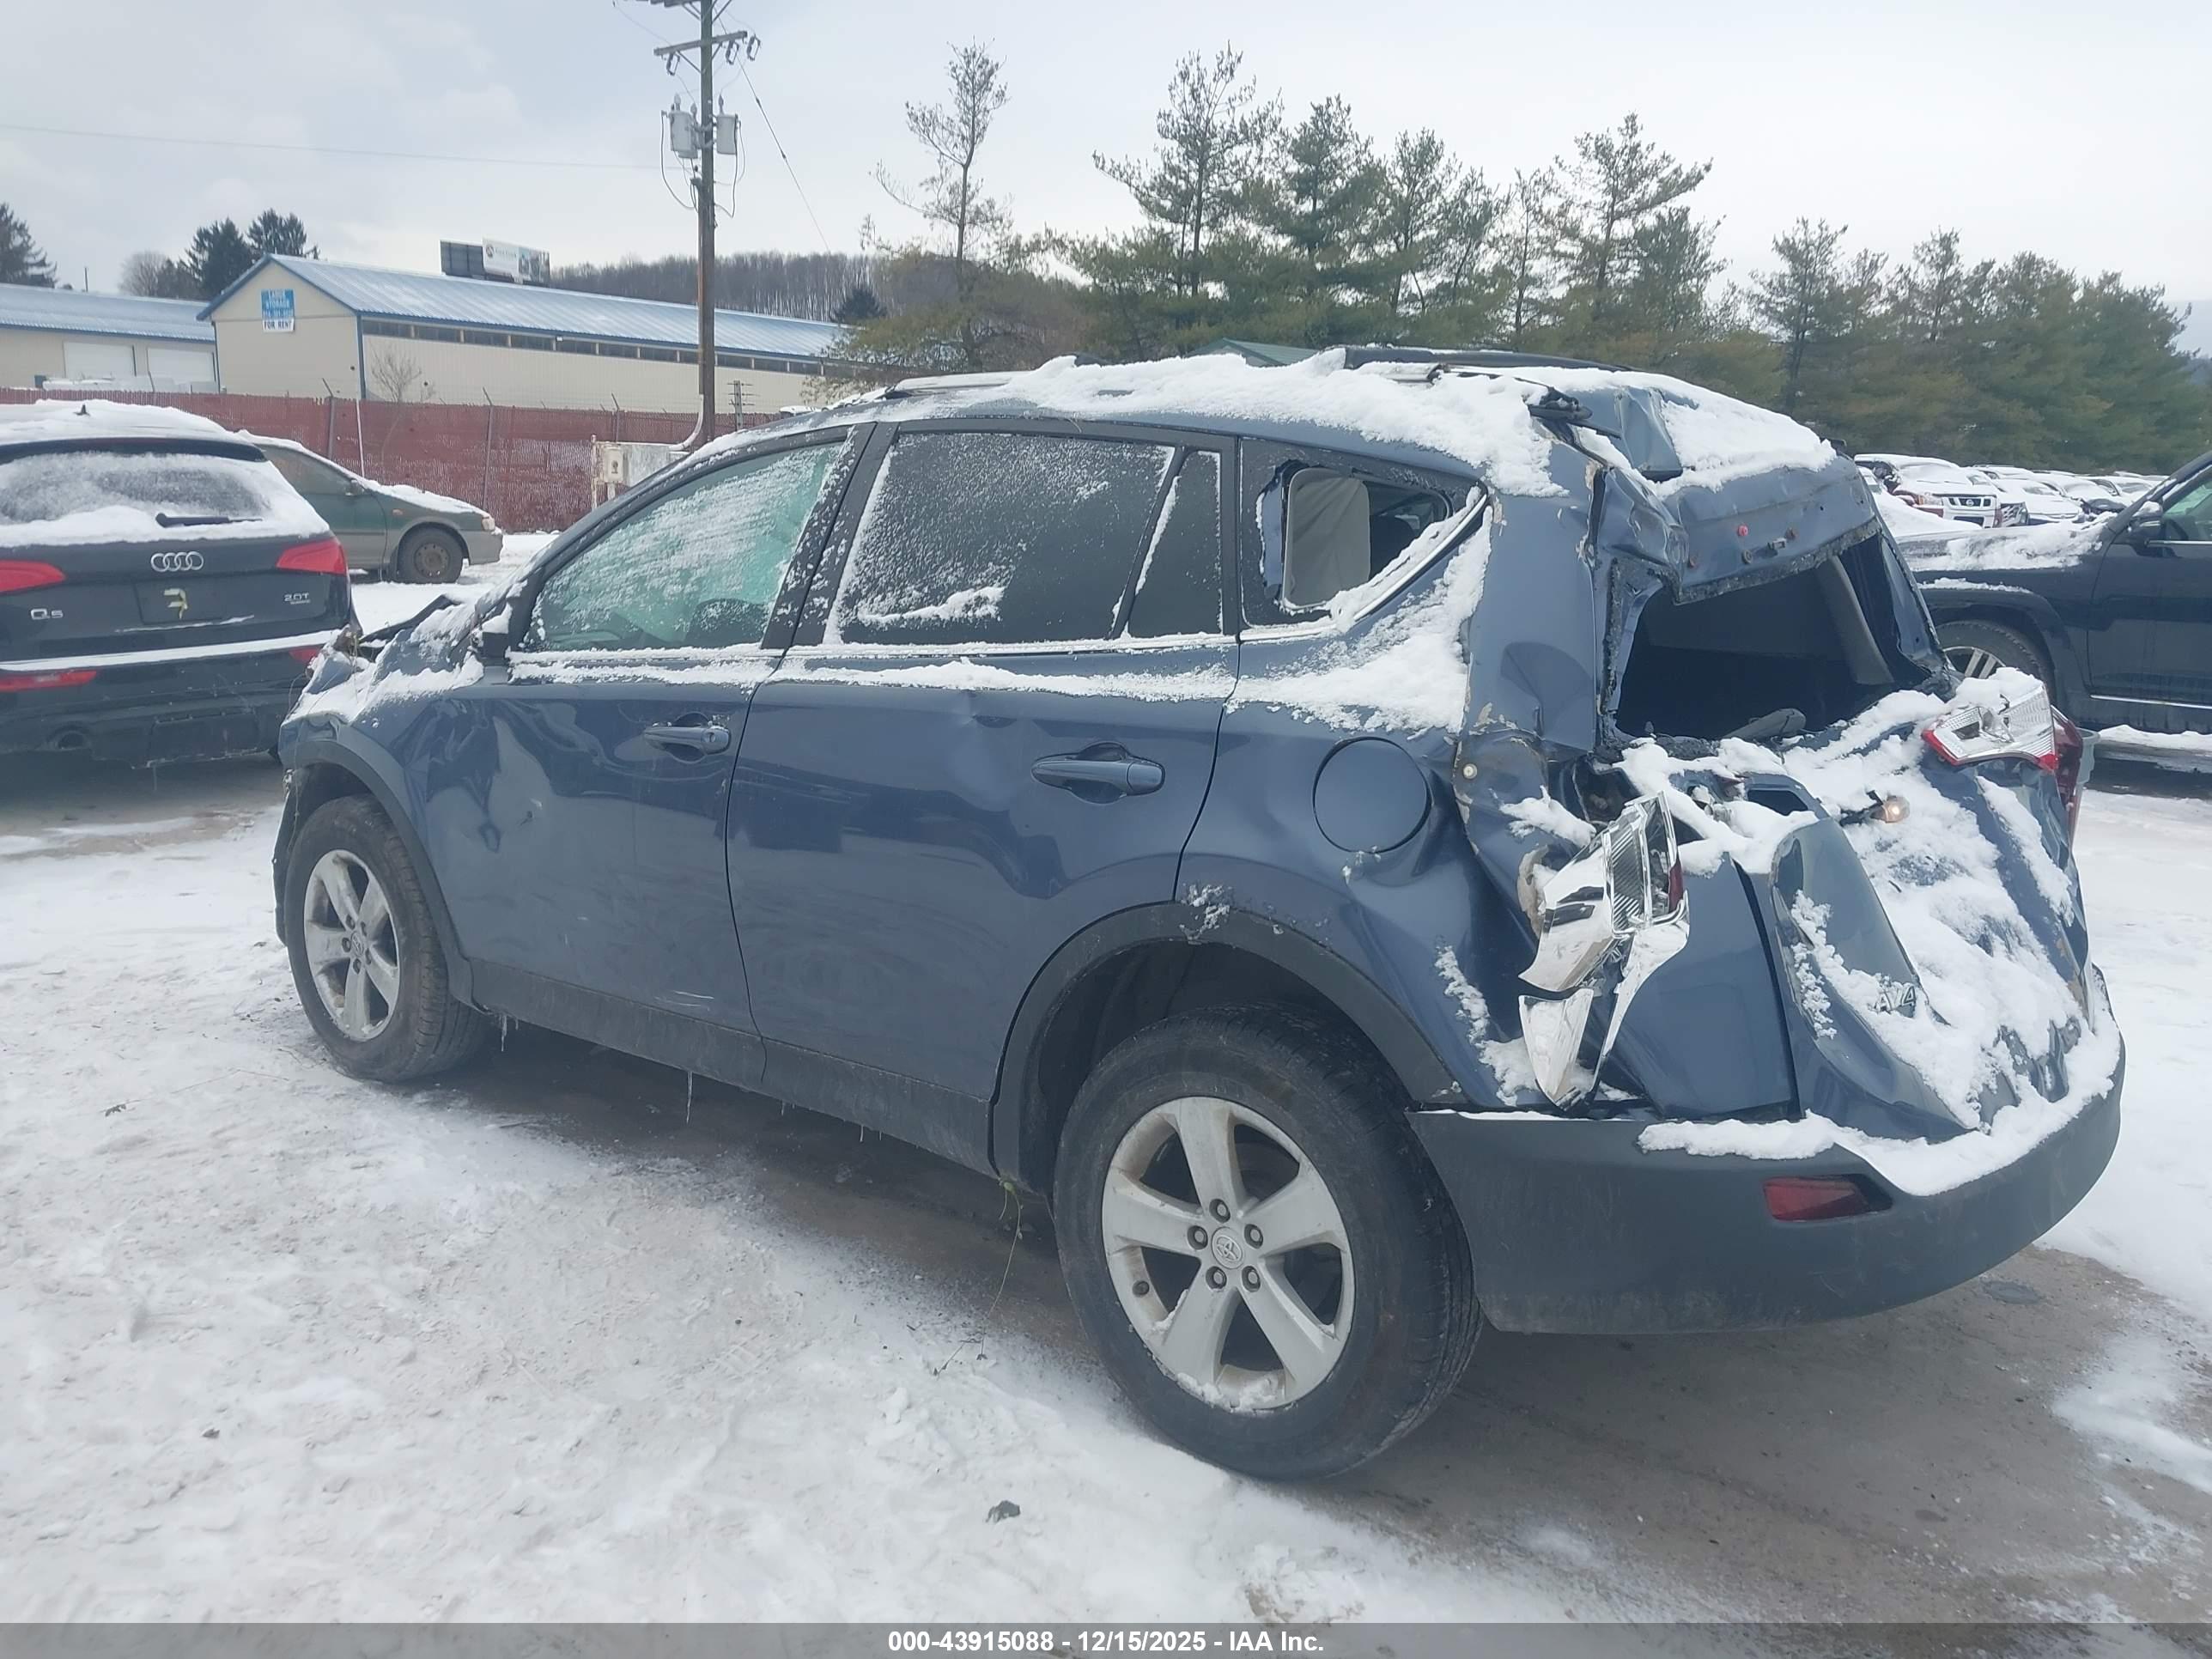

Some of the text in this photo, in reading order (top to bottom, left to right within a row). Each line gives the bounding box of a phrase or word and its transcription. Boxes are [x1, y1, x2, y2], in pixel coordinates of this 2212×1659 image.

[264, 320, 292, 330] FOR RENT
[30, 608, 64, 620] Q5
